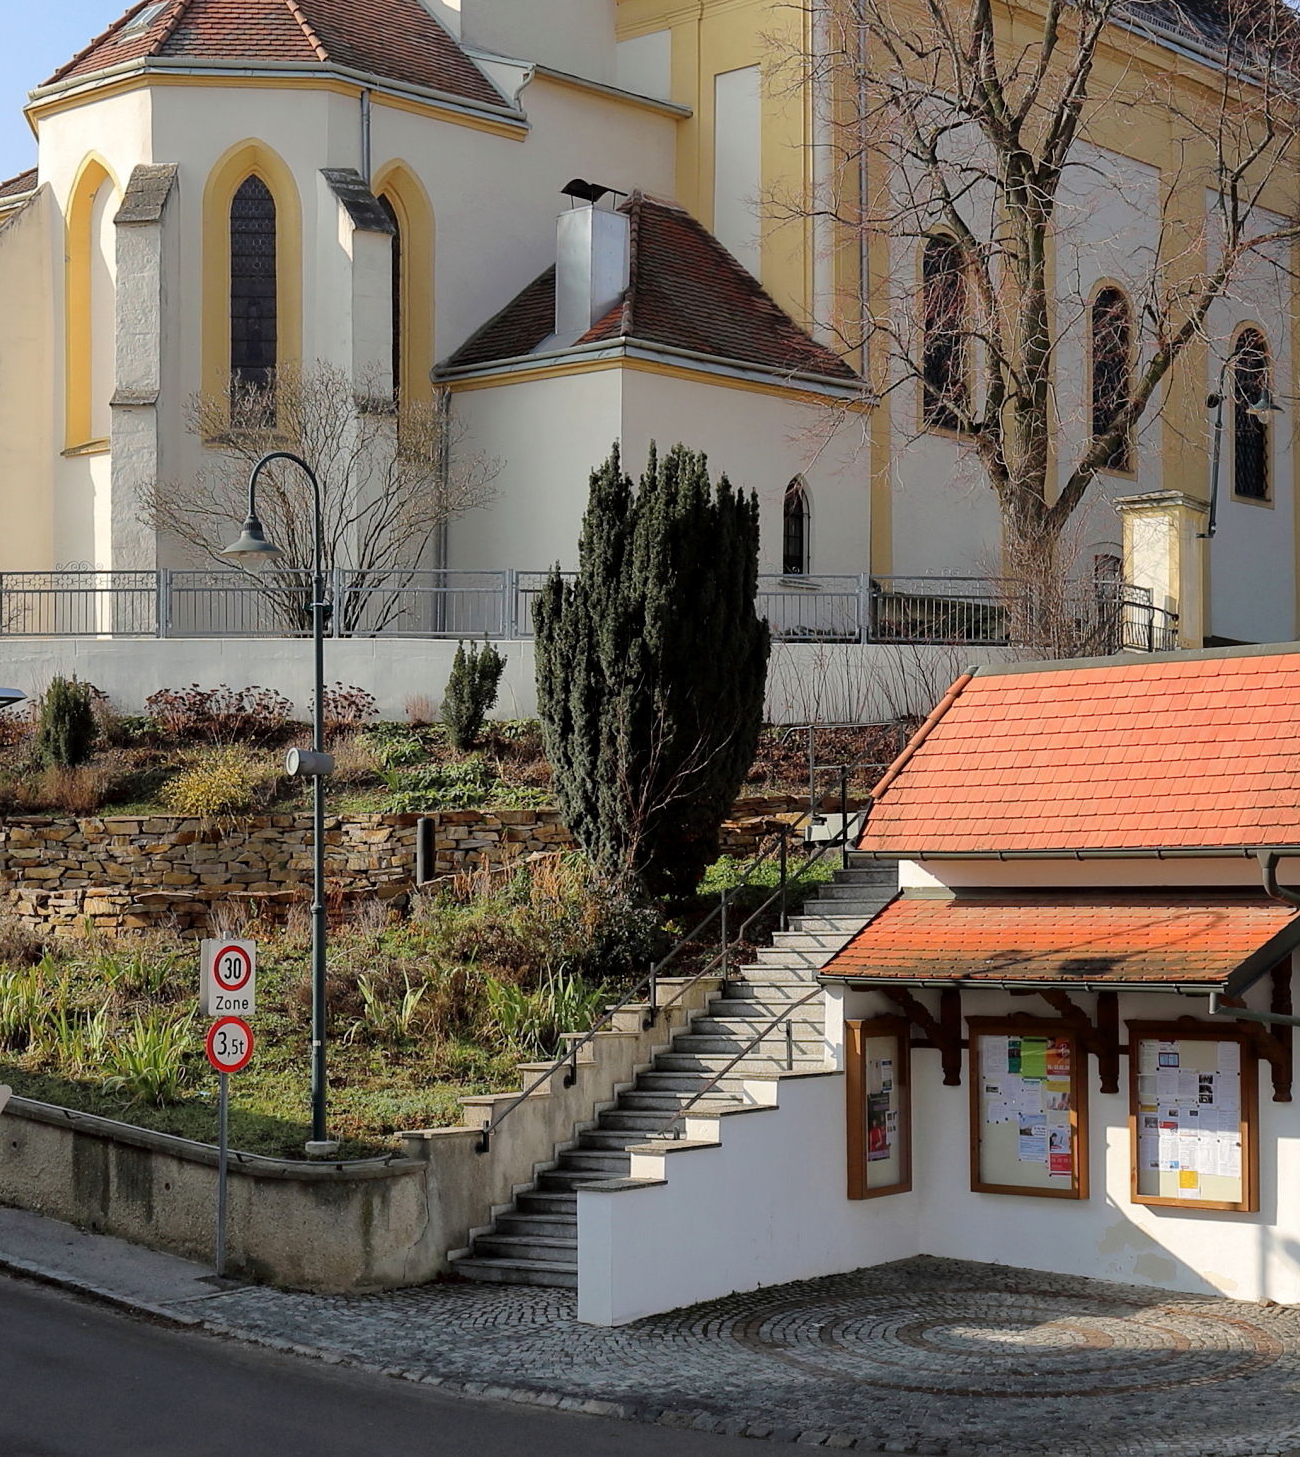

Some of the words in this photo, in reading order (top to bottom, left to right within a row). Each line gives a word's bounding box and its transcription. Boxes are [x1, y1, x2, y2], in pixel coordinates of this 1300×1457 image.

[224, 957, 241, 979] 30
[216, 996, 249, 1010] Zone
[217, 1031, 244, 1057] 3,5t
